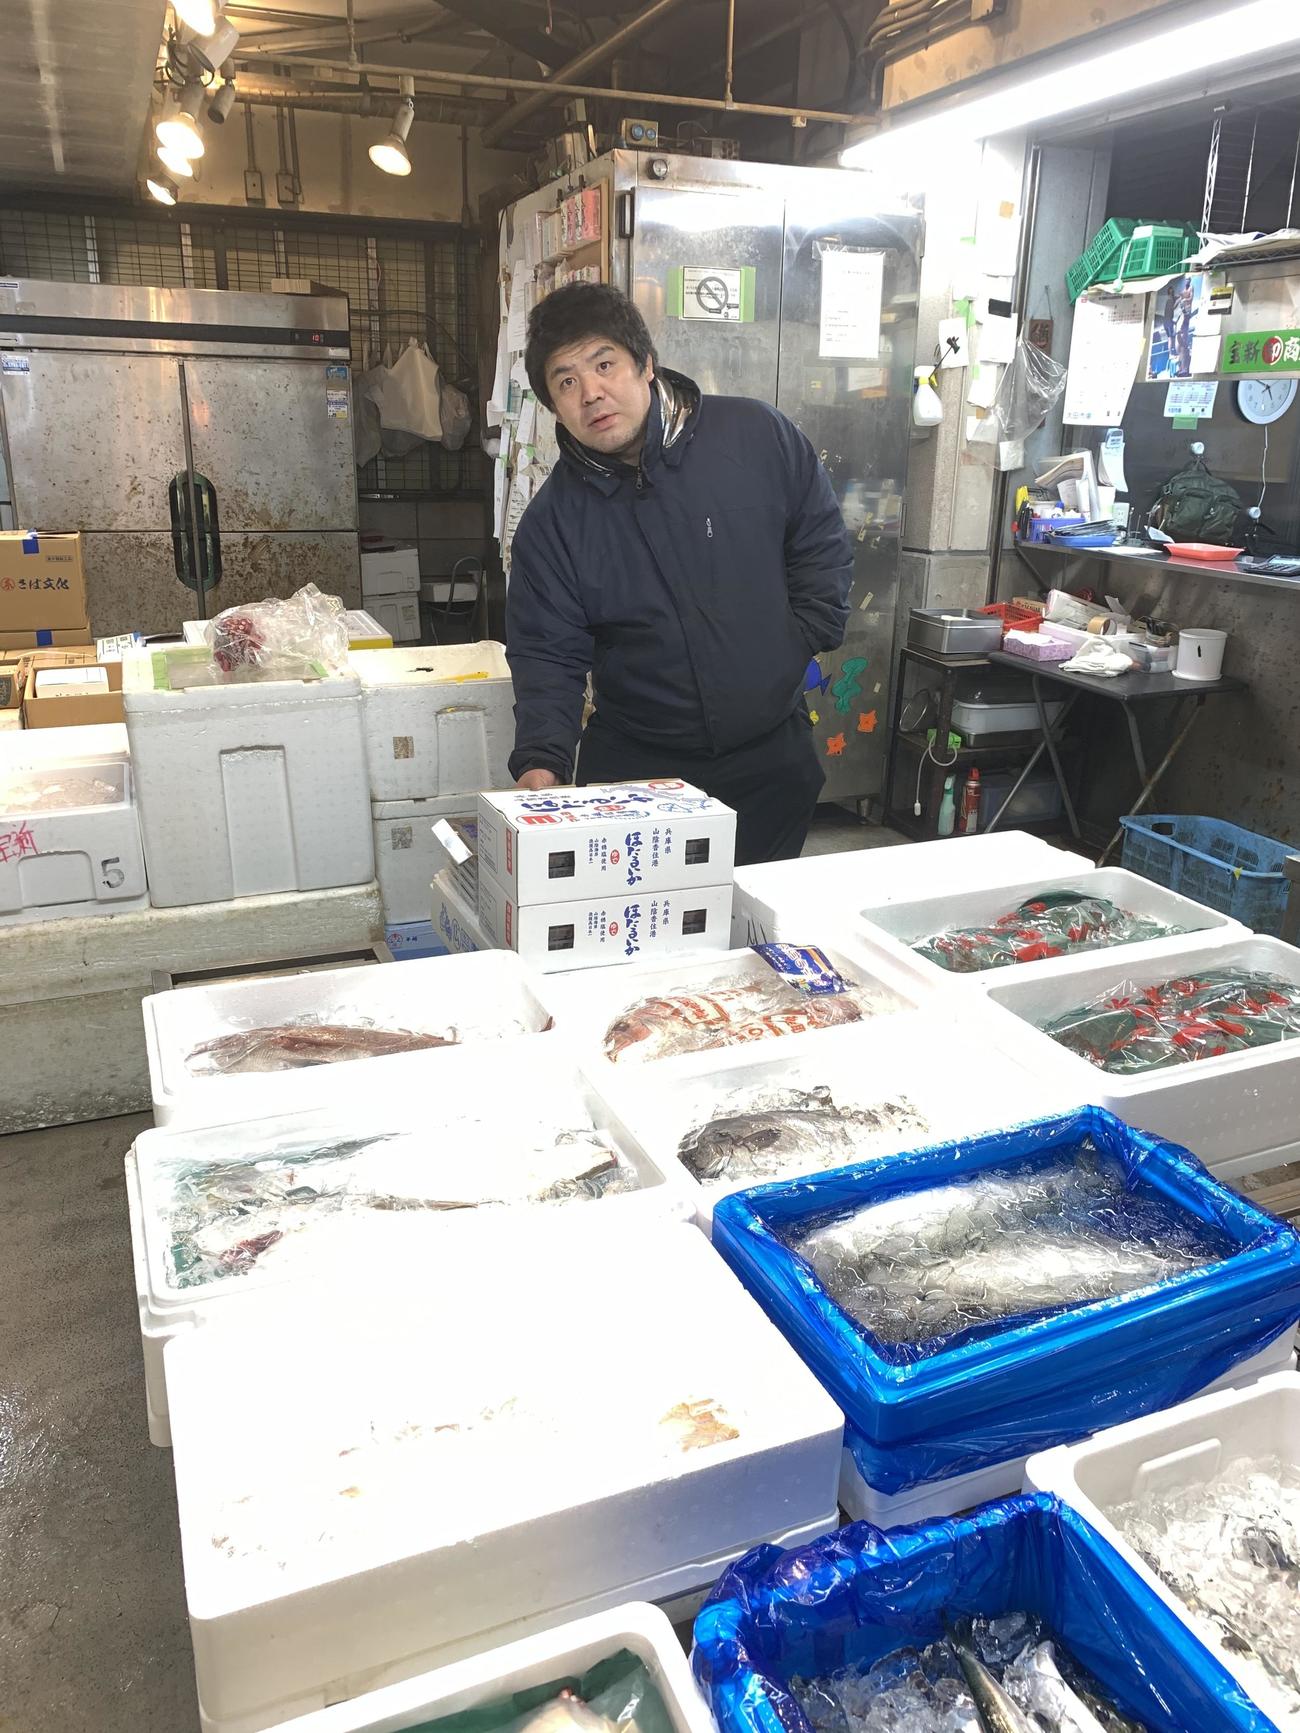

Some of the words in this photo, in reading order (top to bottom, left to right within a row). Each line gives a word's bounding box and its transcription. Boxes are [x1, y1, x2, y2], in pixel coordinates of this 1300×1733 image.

[101, 857, 125, 889] 5
[625, 831, 643, 886] ほたるいか
[623, 904, 641, 956] ほたるいか
